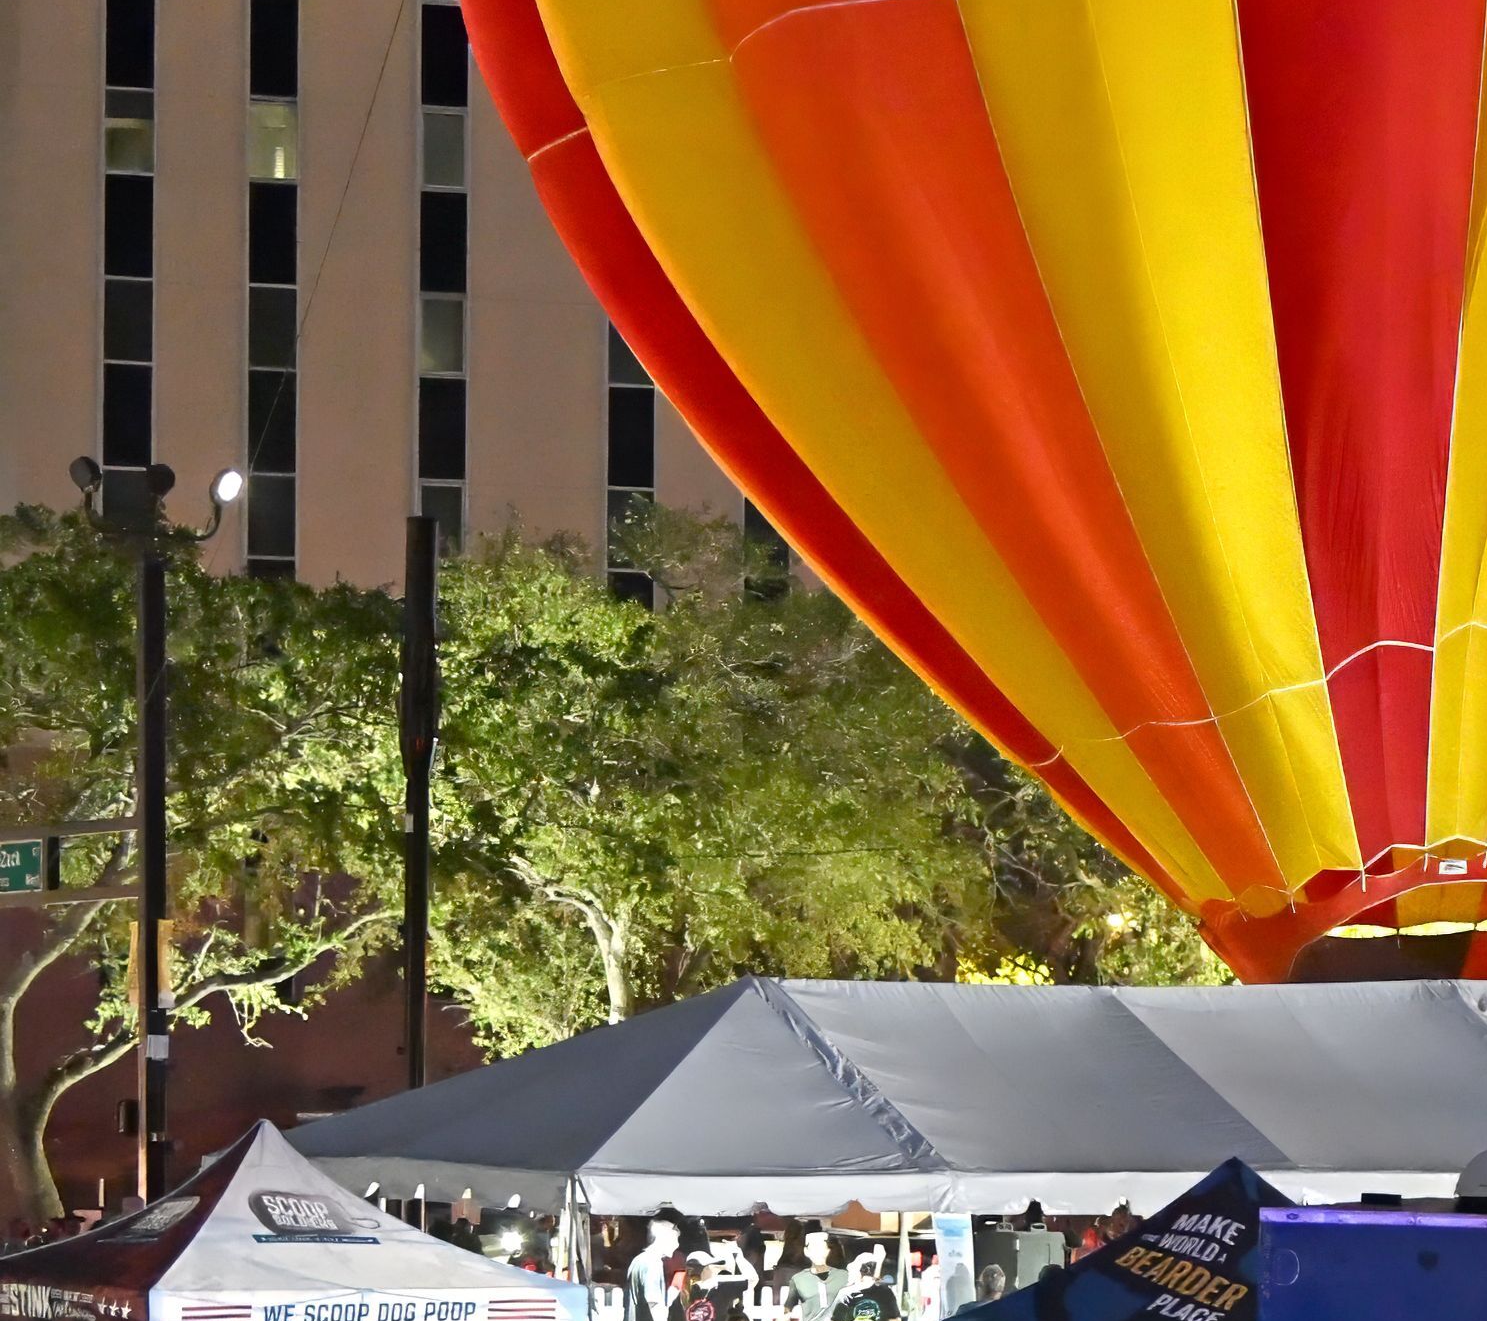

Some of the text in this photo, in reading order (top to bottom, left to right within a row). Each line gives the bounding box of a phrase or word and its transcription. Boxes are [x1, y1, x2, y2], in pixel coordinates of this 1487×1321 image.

[262, 1195, 328, 1216] SCOOP
[1171, 1214, 1246, 1246] MAKE
[1158, 1233, 1220, 1262] WORLD
[1115, 1246, 1249, 1310] BEARDER
[10, 1283, 52, 1320] STINK
[424, 1302, 476, 1321] POOP
